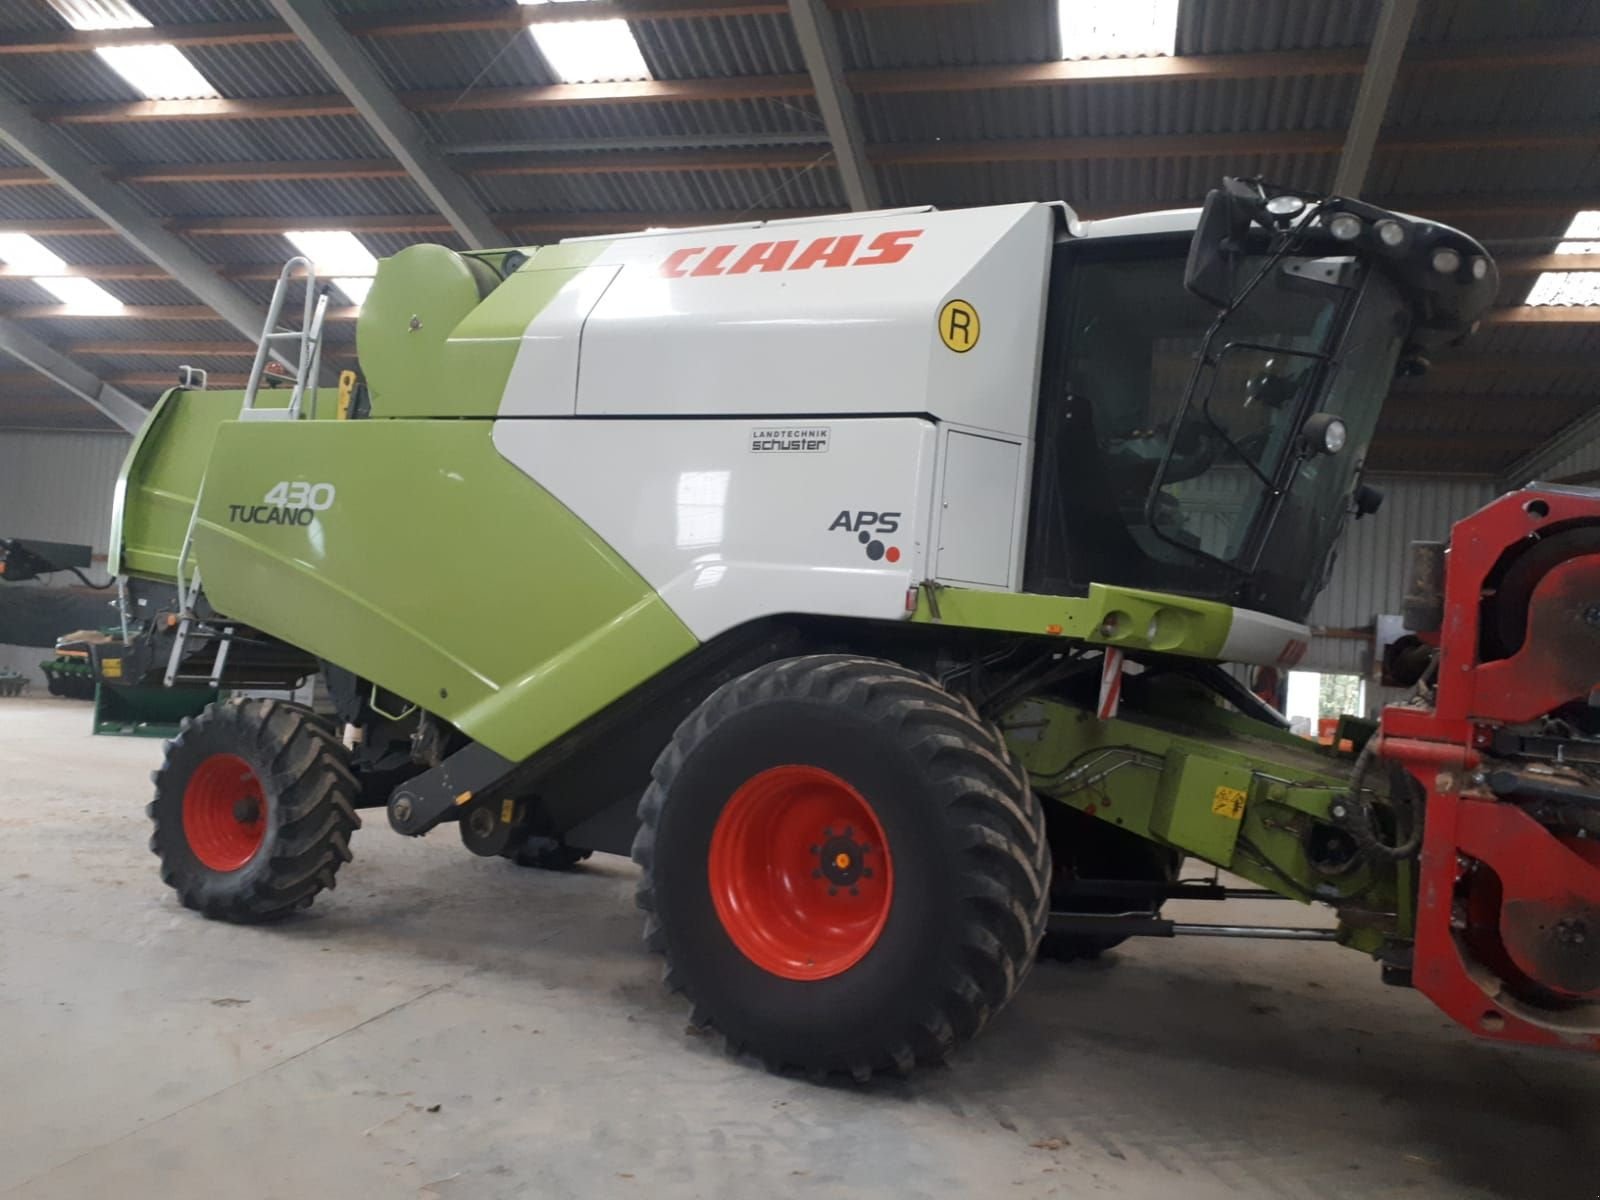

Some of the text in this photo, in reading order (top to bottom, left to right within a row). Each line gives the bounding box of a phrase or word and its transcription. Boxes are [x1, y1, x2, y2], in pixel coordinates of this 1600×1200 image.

[658, 229, 924, 279] CLAAS
[949, 308, 970, 344] R
[752, 438, 826, 451] schuster
[753, 430, 827, 438] LANDTECHNIK
[264, 481, 336, 511] 430
[228, 504, 314, 526] TUCANO
[828, 510, 901, 533] APS
